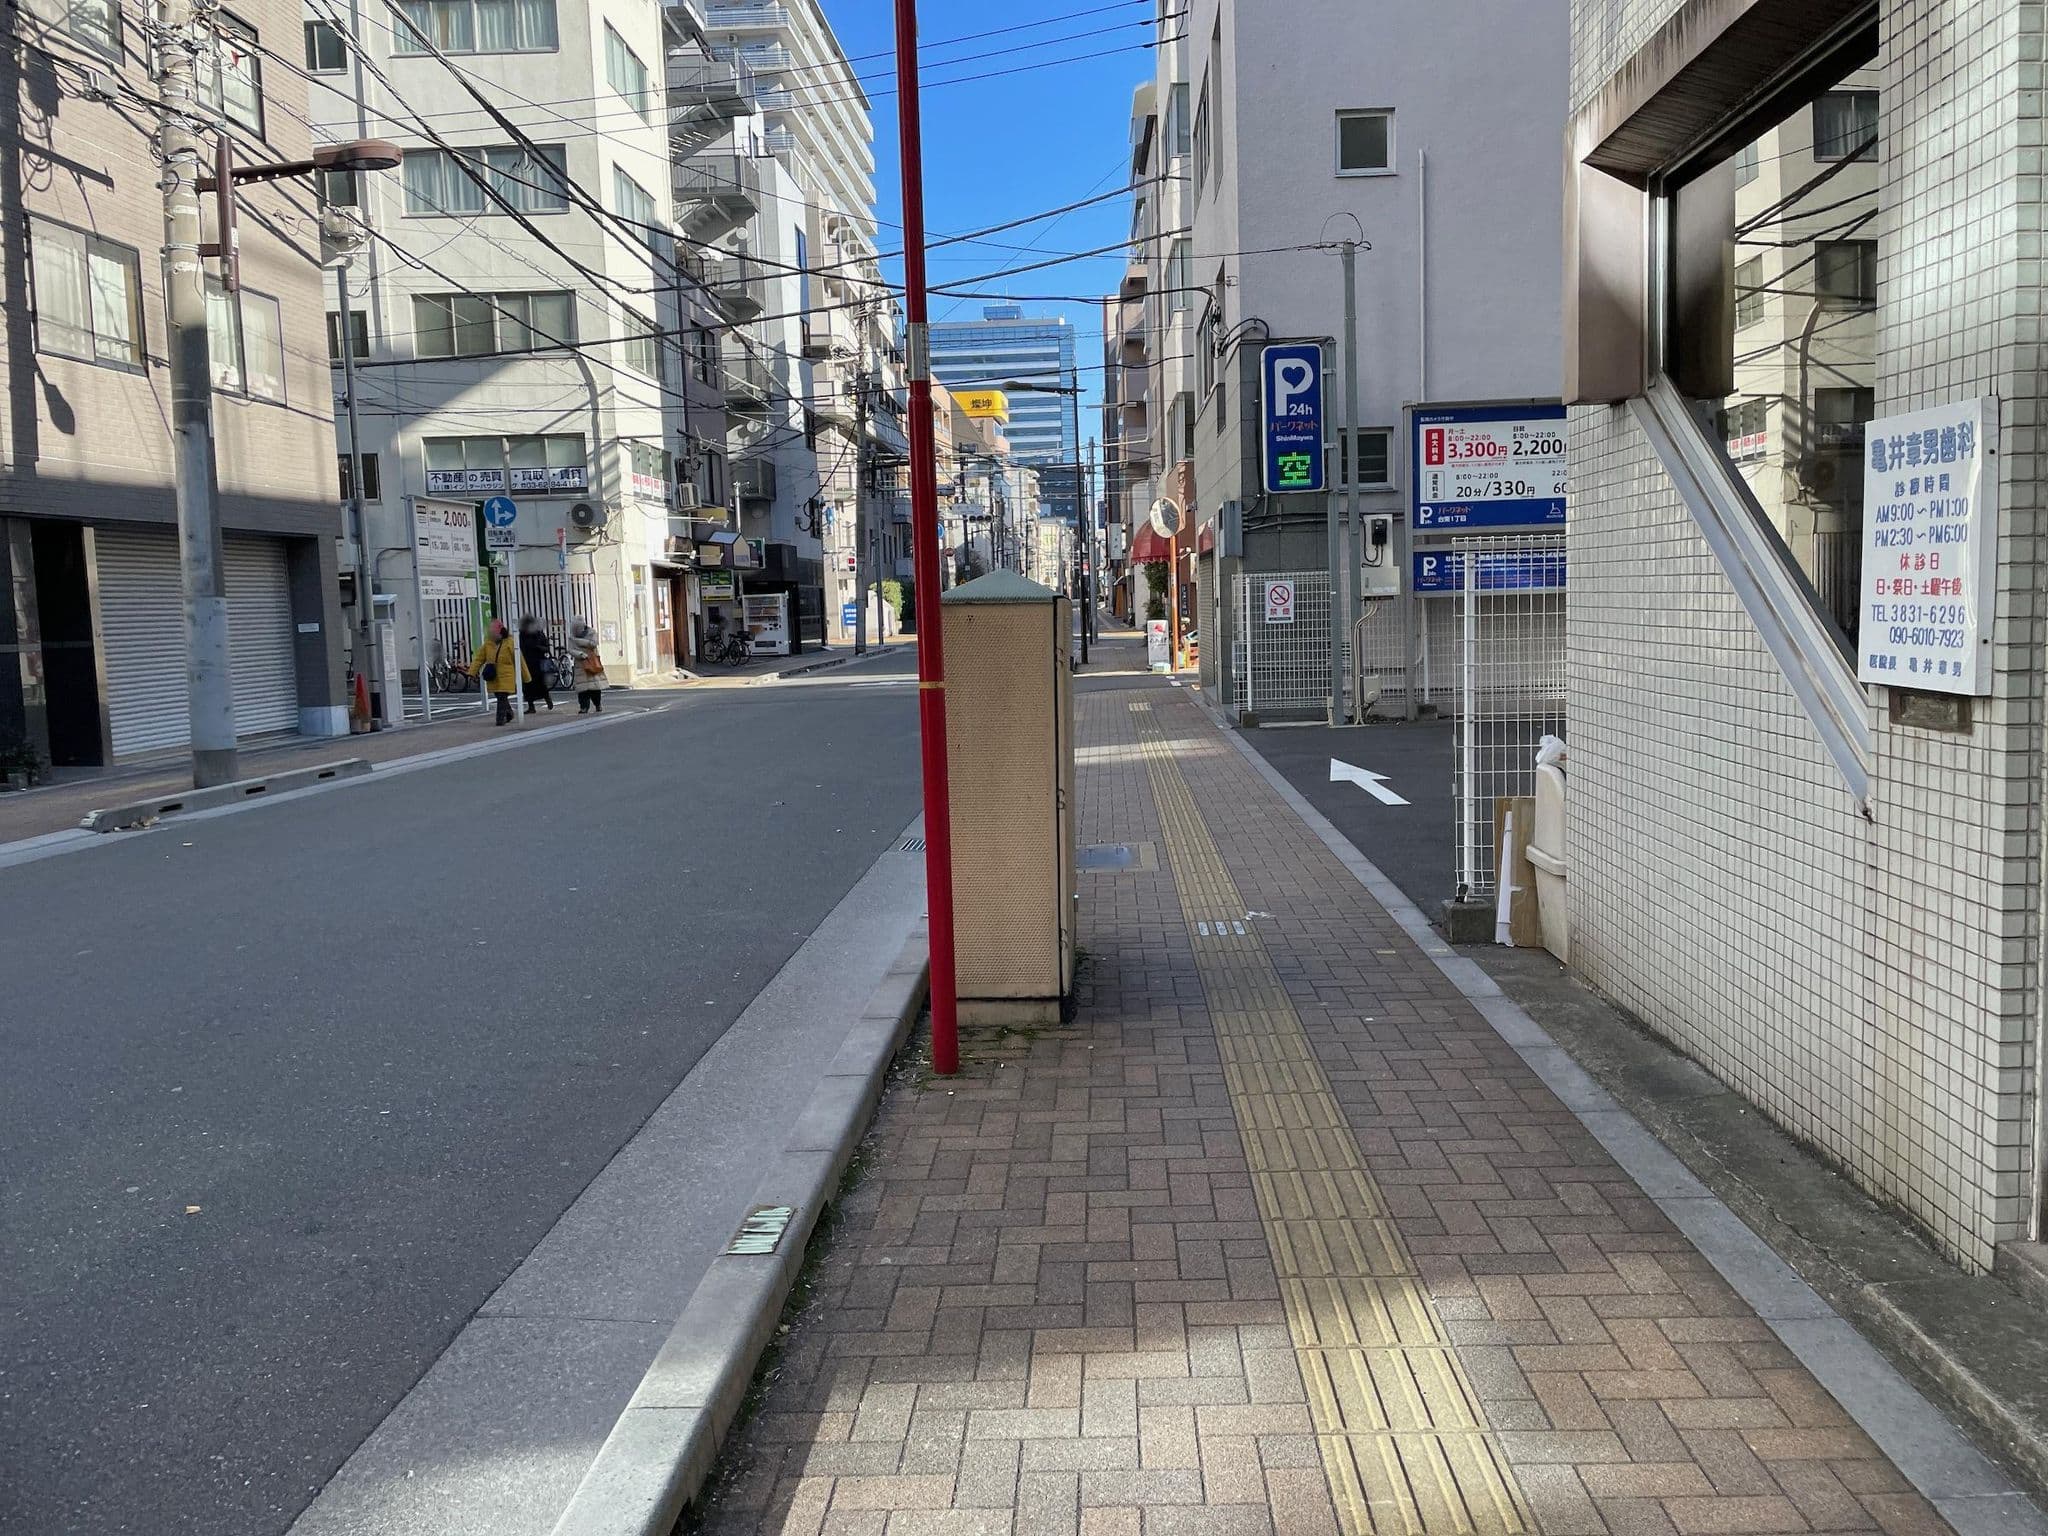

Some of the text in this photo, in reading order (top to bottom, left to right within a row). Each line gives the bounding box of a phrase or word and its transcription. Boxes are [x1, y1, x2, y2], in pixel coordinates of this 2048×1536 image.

[1289, 403, 1313, 416] 24h
[1270, 420, 1319, 433] パークネット
[1448, 441, 1508, 459] 3,300円
[1512, 439, 1567, 457] 2,200
[1870, 420, 1976, 473] 亀井章男歯科
[1278, 452, 1312, 486] 空
[1894, 473, 1950, 498] 診療時間
[1900, 552, 1940, 571] 休診日
[1890, 604, 1965, 625] 3831-6296
[1889, 626, 1965, 649] 090-6010-7923
[1909, 656, 1962, 678] 亀井章男
